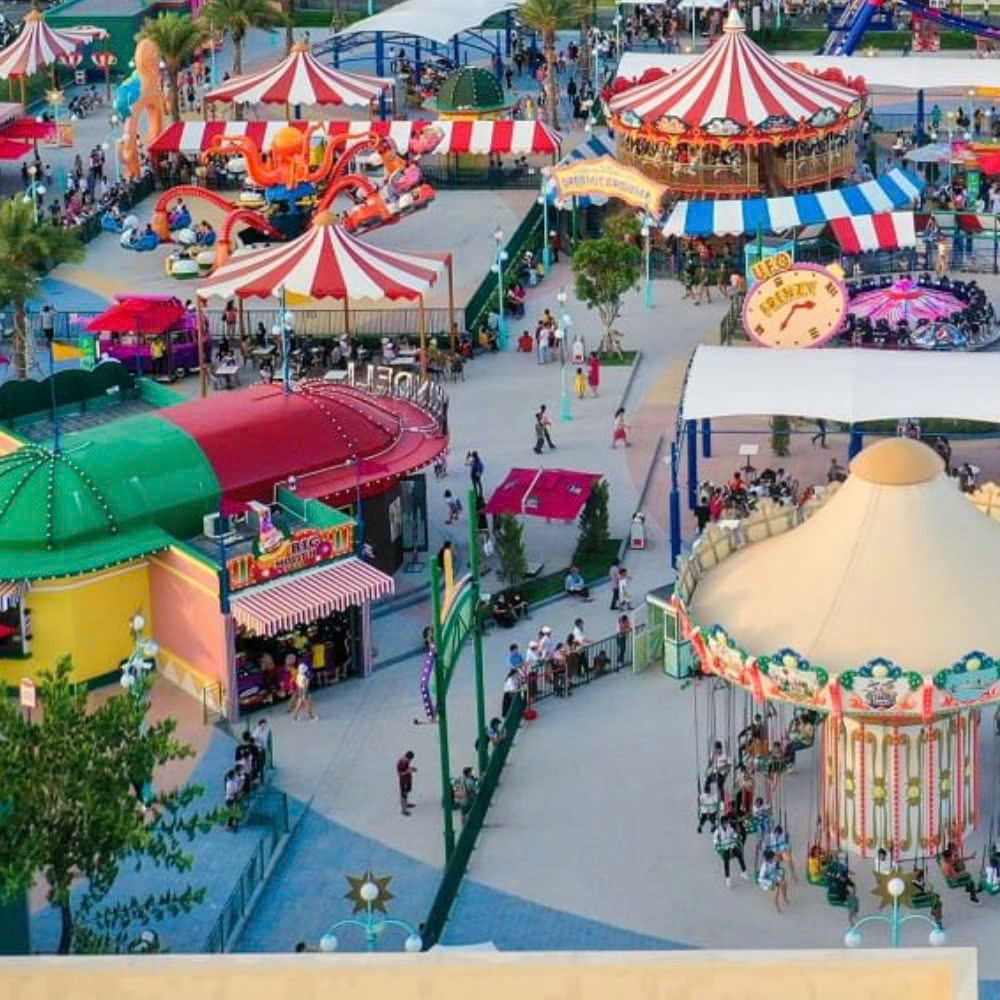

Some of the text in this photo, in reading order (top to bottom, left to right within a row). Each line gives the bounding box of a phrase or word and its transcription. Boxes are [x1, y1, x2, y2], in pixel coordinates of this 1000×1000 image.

[752, 251, 791, 280] UFO
[759, 281, 818, 318] FRENZY
[292, 537, 320, 554] BIG
